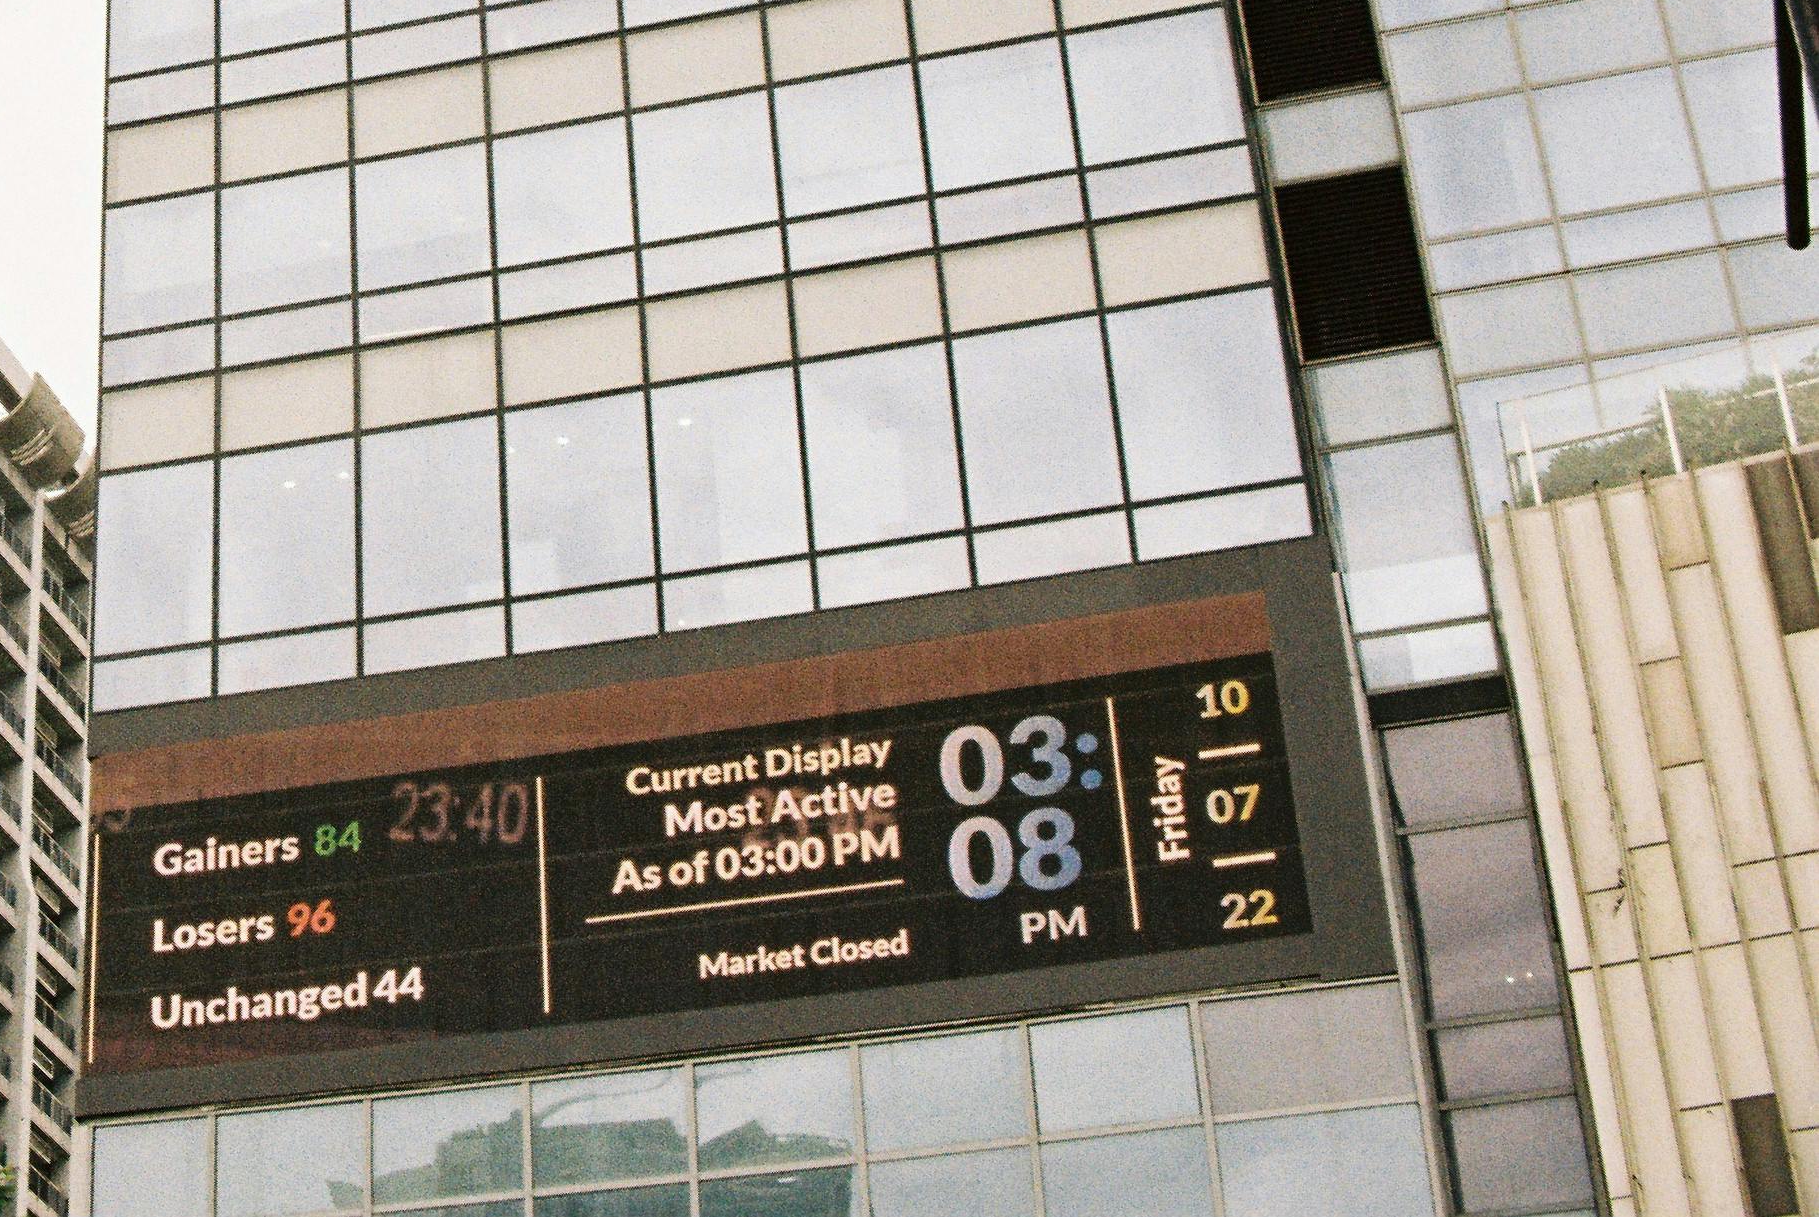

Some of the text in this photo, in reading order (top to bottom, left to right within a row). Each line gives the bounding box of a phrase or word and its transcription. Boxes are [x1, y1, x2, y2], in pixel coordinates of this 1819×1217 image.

[1196, 679, 1250, 719] 10
[626, 737, 892, 795] Current Display
[940, 715, 1103, 806] 03:
[664, 795, 762, 837] Most
[771, 782, 897, 824] Active
[1149, 756, 1191, 862] Friday
[1206, 784, 1260, 824] 07
[152, 821, 361, 876] Gainers 84
[611, 825, 901, 894] As of 03:00 PM
[949, 807, 1082, 900] 08
[153, 899, 336, 952] Losers 96
[1020, 905, 1088, 944] PM
[1221, 888, 1278, 929] 22
[698, 928, 909, 979] Market Closed
[151, 966, 424, 1029] Unchanged 44
